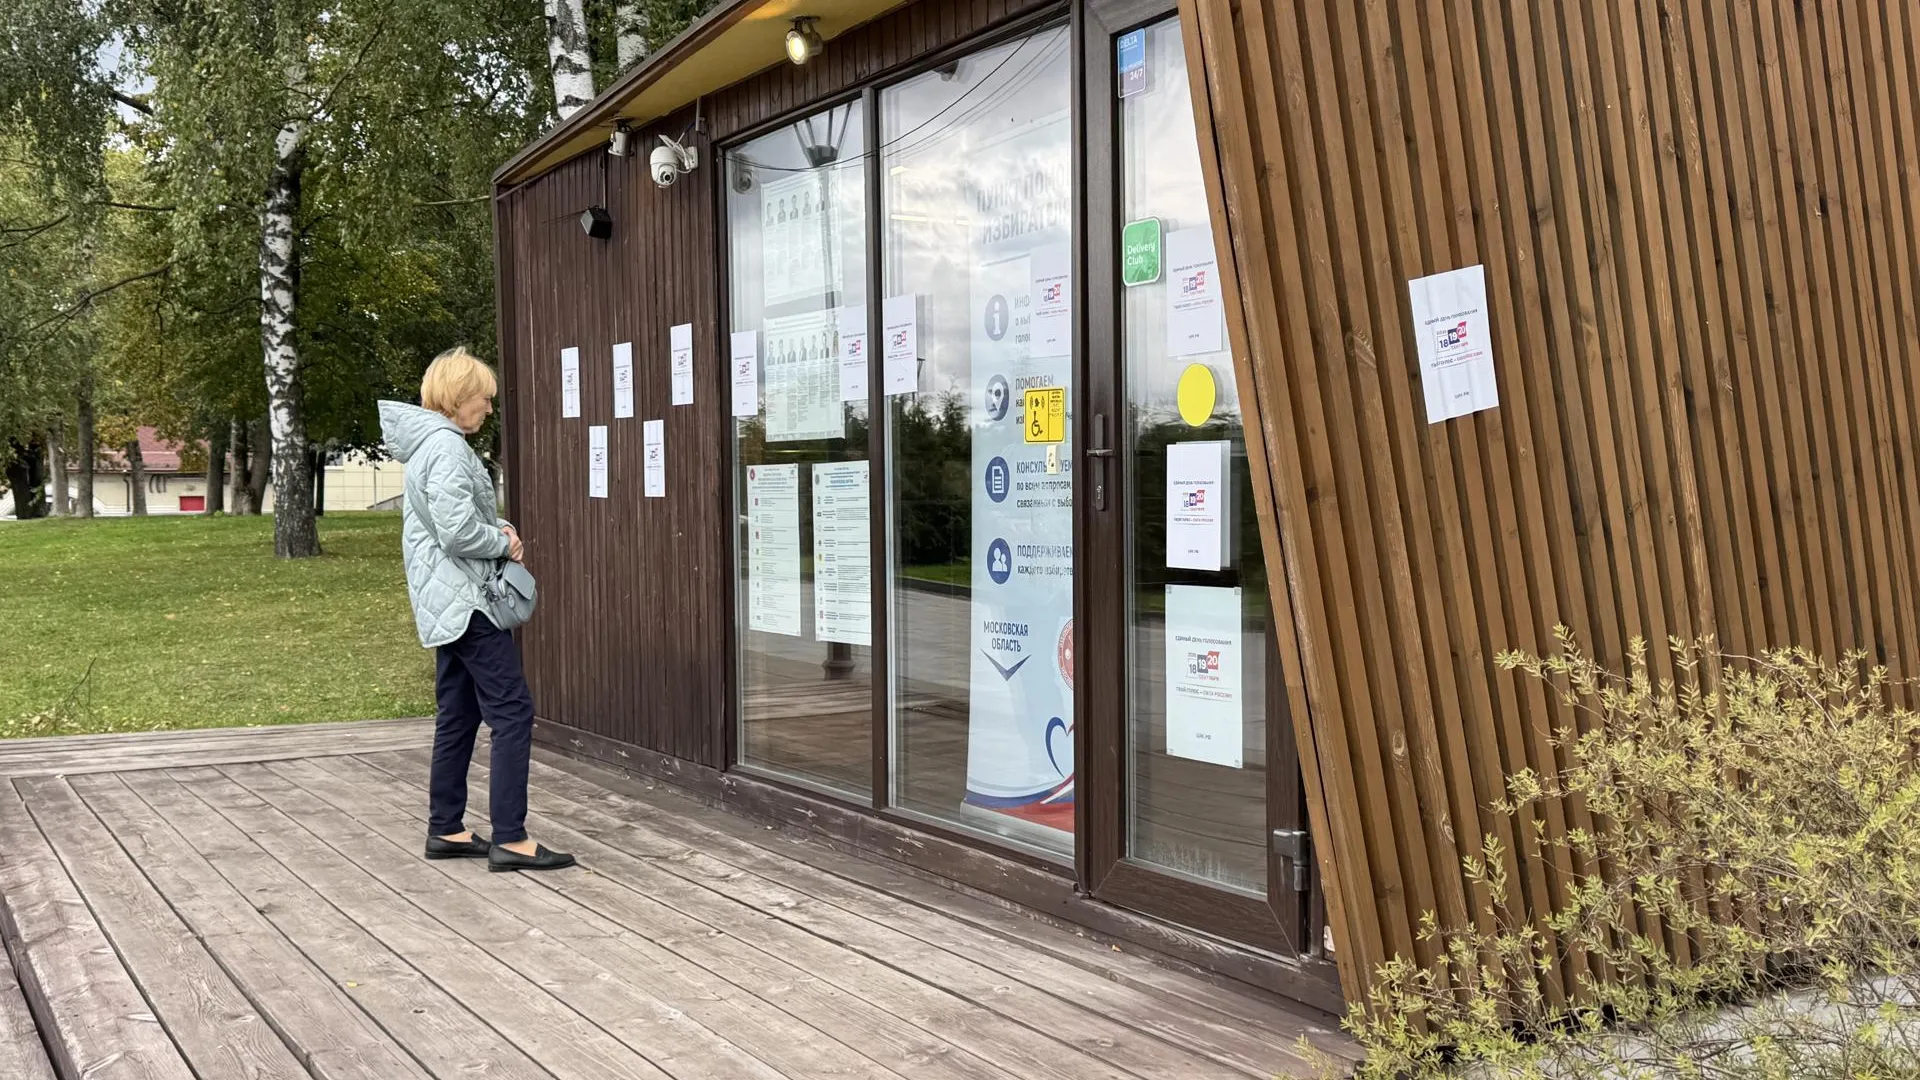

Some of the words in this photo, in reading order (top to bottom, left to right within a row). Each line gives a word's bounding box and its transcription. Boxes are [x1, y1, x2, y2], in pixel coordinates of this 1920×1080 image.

[1129, 67, 1143, 80] 24/7
[1127, 241, 1155, 255] Delivery
[1127, 254, 1144, 266] Club
[1439, 338, 1449, 348] 18
[1016, 374, 1053, 391] ПОМОГАЕМ
[1017, 482, 1024, 490] по
[1025, 481, 1040, 491] всем
[1018, 565, 1043, 575] каждого
[983, 620, 1029, 636] МОСКОВСКАЯ
[991, 637, 1022, 652] ОБЛАСТЬ
[1189, 664, 1197, 674] 18
[1198, 659, 1207, 670] 19
[1207, 655, 1218, 666] 20
